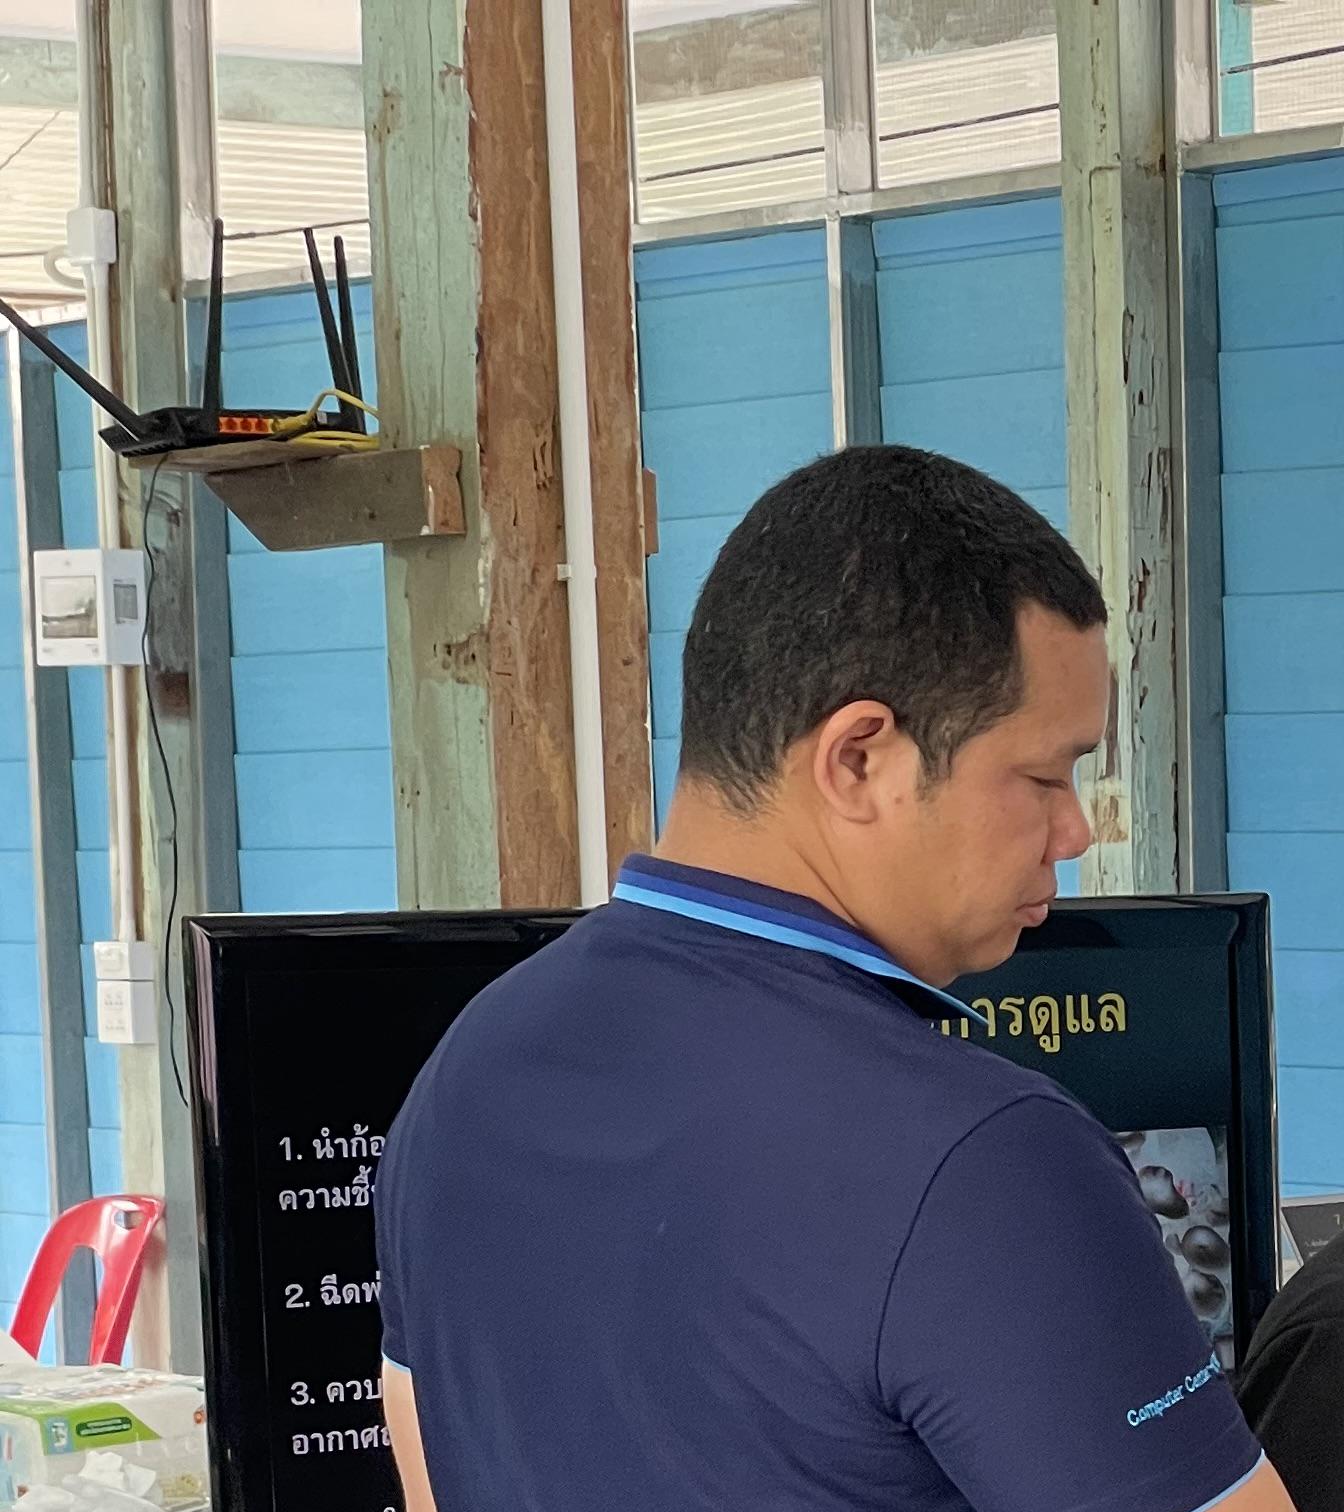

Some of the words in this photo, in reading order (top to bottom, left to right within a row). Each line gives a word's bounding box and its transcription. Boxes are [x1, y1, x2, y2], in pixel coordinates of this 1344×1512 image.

[279, 1136, 303, 1161] 1.
[278, 1165, 376, 1211] ความชื้
[285, 1283, 310, 1308] 2.
[290, 1381, 316, 1406] 3.
[1127, 1385, 1184, 1427] Computer
